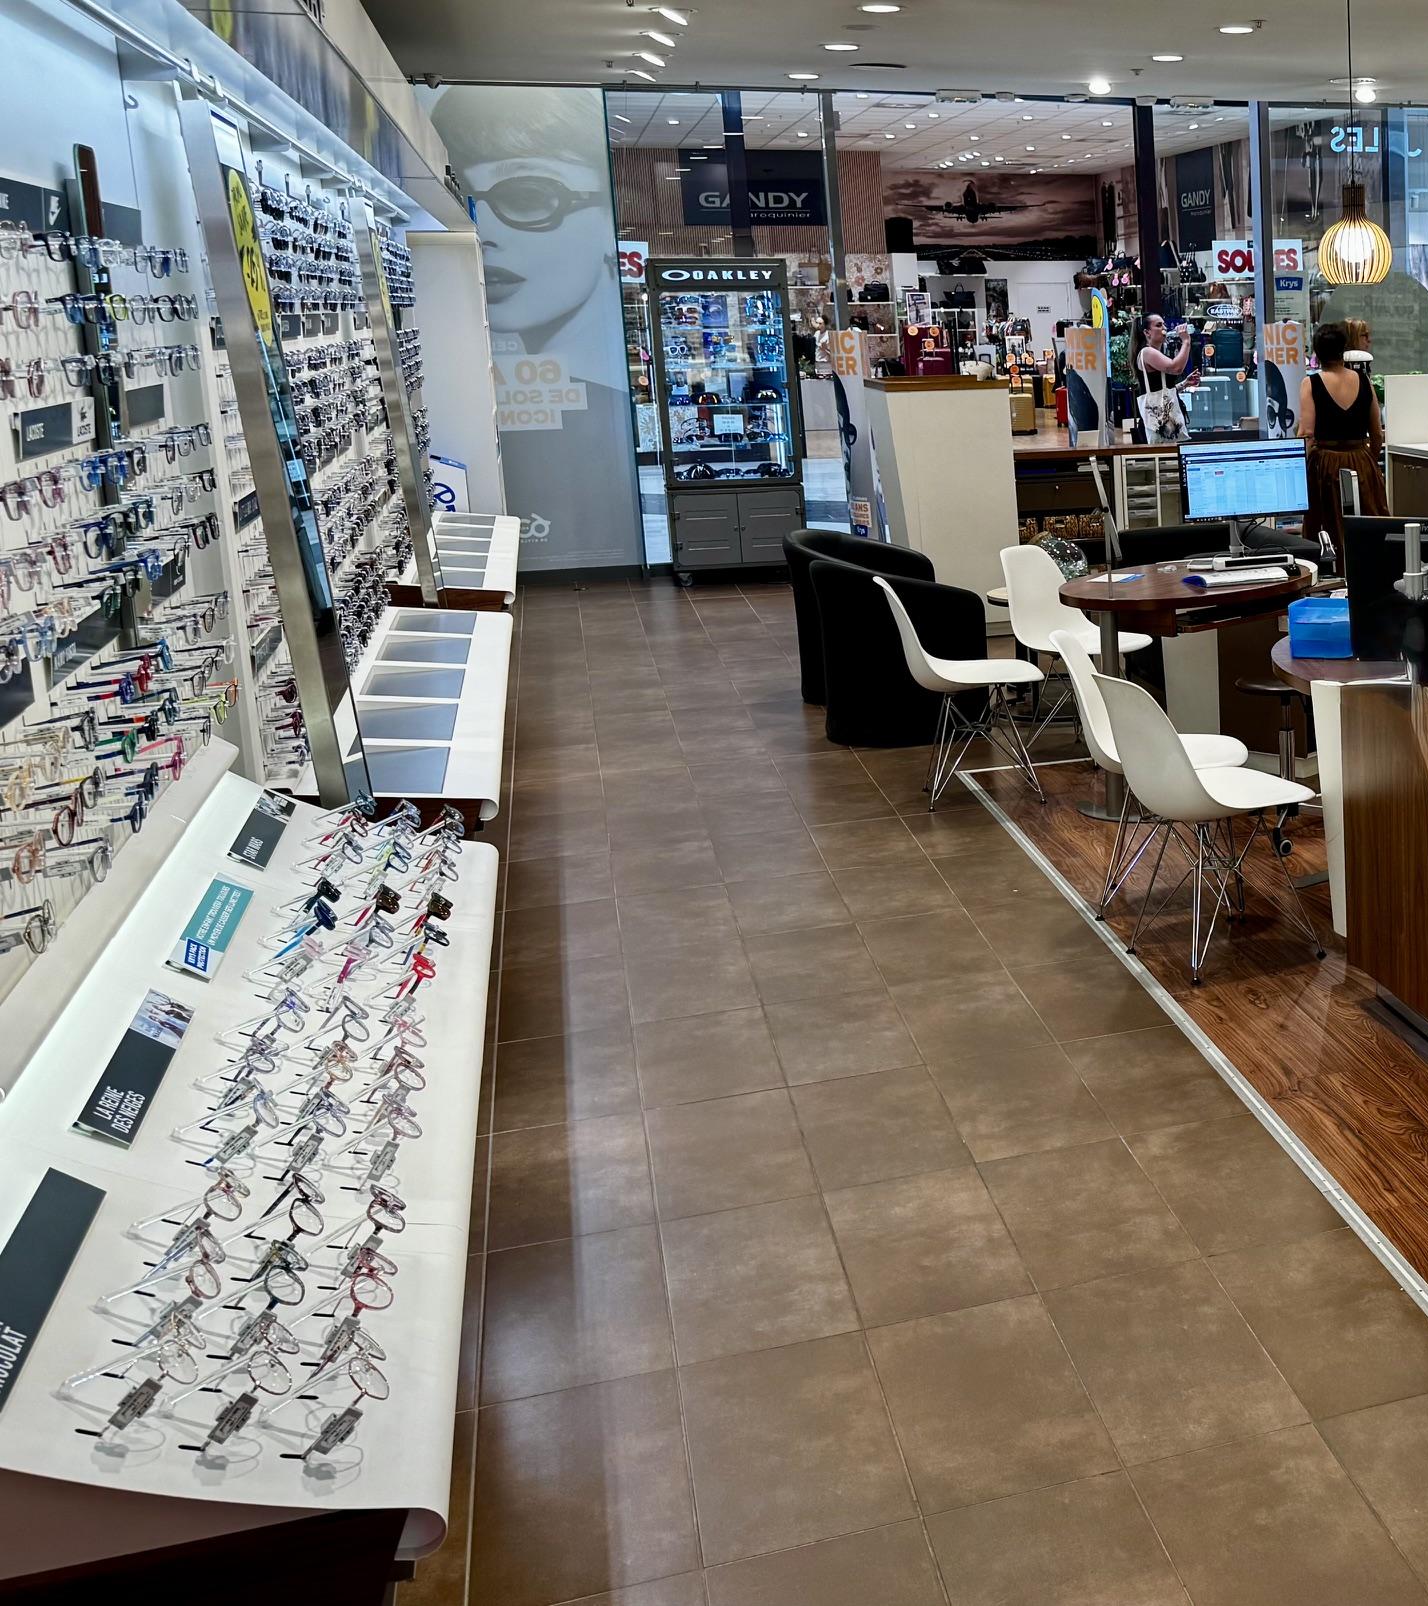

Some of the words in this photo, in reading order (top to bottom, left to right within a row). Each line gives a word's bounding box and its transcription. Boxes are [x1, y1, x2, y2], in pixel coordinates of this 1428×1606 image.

[1181, 189, 1210, 208] GANDY
[1217, 248, 1299, 274] SOLES
[692, 270, 772, 280] OAKLEY
[1280, 279, 1299, 288] Krys
[1264, 325, 1298, 345] NIC
[98, 1086, 124, 1111] REINE
[118, 1090, 146, 1120] NEIGES
[92, 1106, 114, 1120] LA
[111, 1114, 134, 1134] DES
